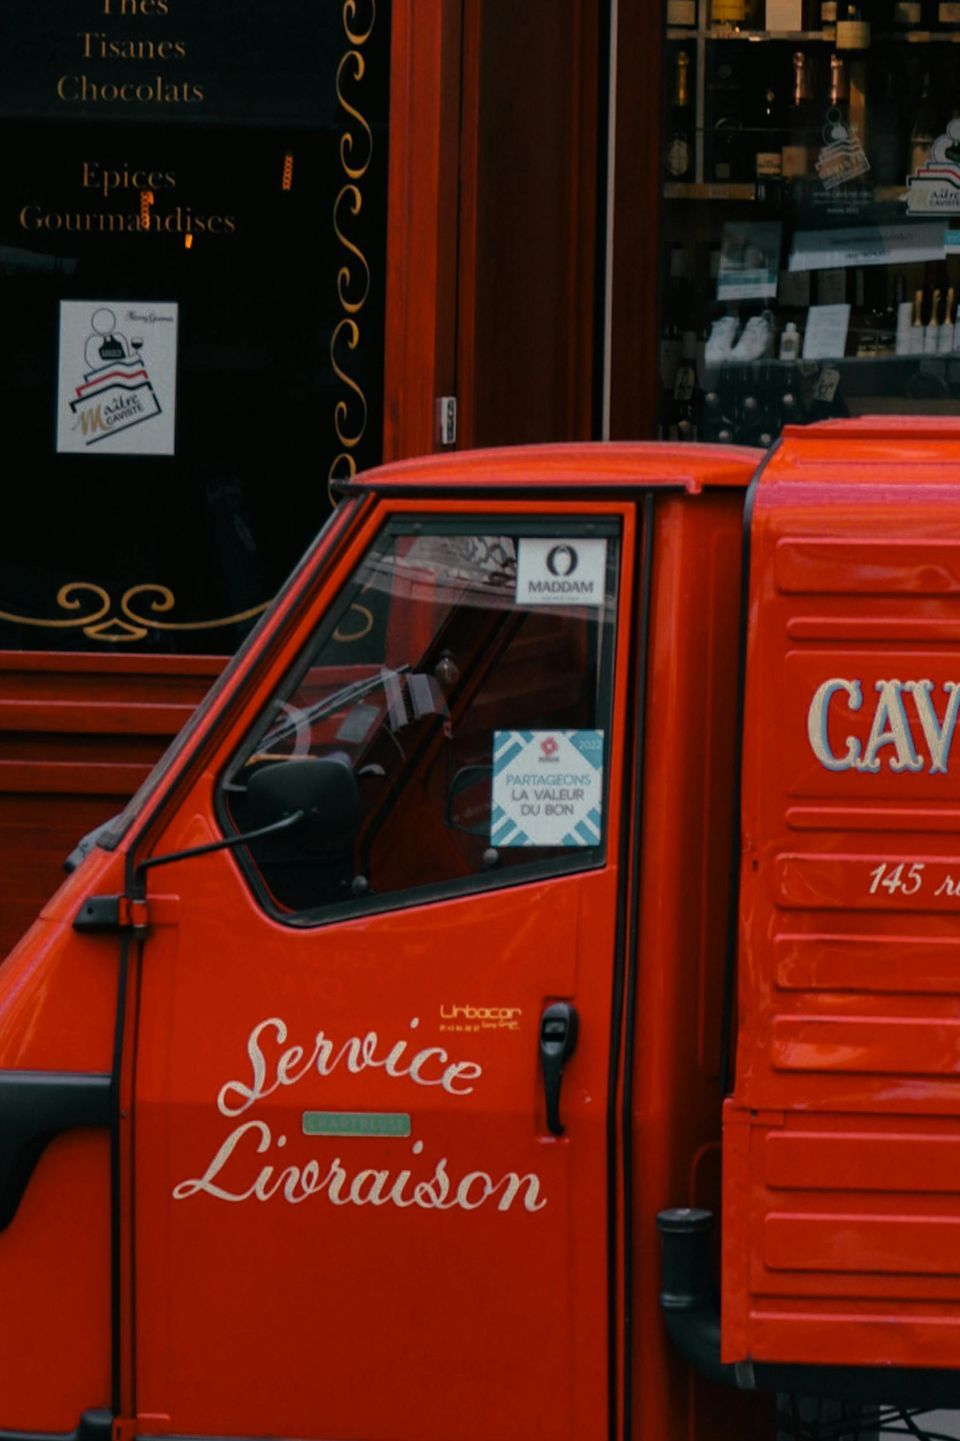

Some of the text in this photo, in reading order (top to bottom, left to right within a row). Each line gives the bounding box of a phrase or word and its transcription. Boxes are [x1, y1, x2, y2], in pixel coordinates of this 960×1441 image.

[77, 32, 186, 59] Tisanes
[57, 75, 204, 102] Chocolats
[82, 162, 176, 197] Epices
[18, 205, 236, 233] Gourmandises
[528, 581, 594, 593] MADDAM
[506, 773, 592, 786] PARTAGEONS
[512, 789, 585, 801] LA VALEUR
[521, 804, 574, 816] DU BON
[868, 863, 925, 895] 145
[217, 1017, 482, 1117] Service
[172, 1120, 548, 1212] Livraison
